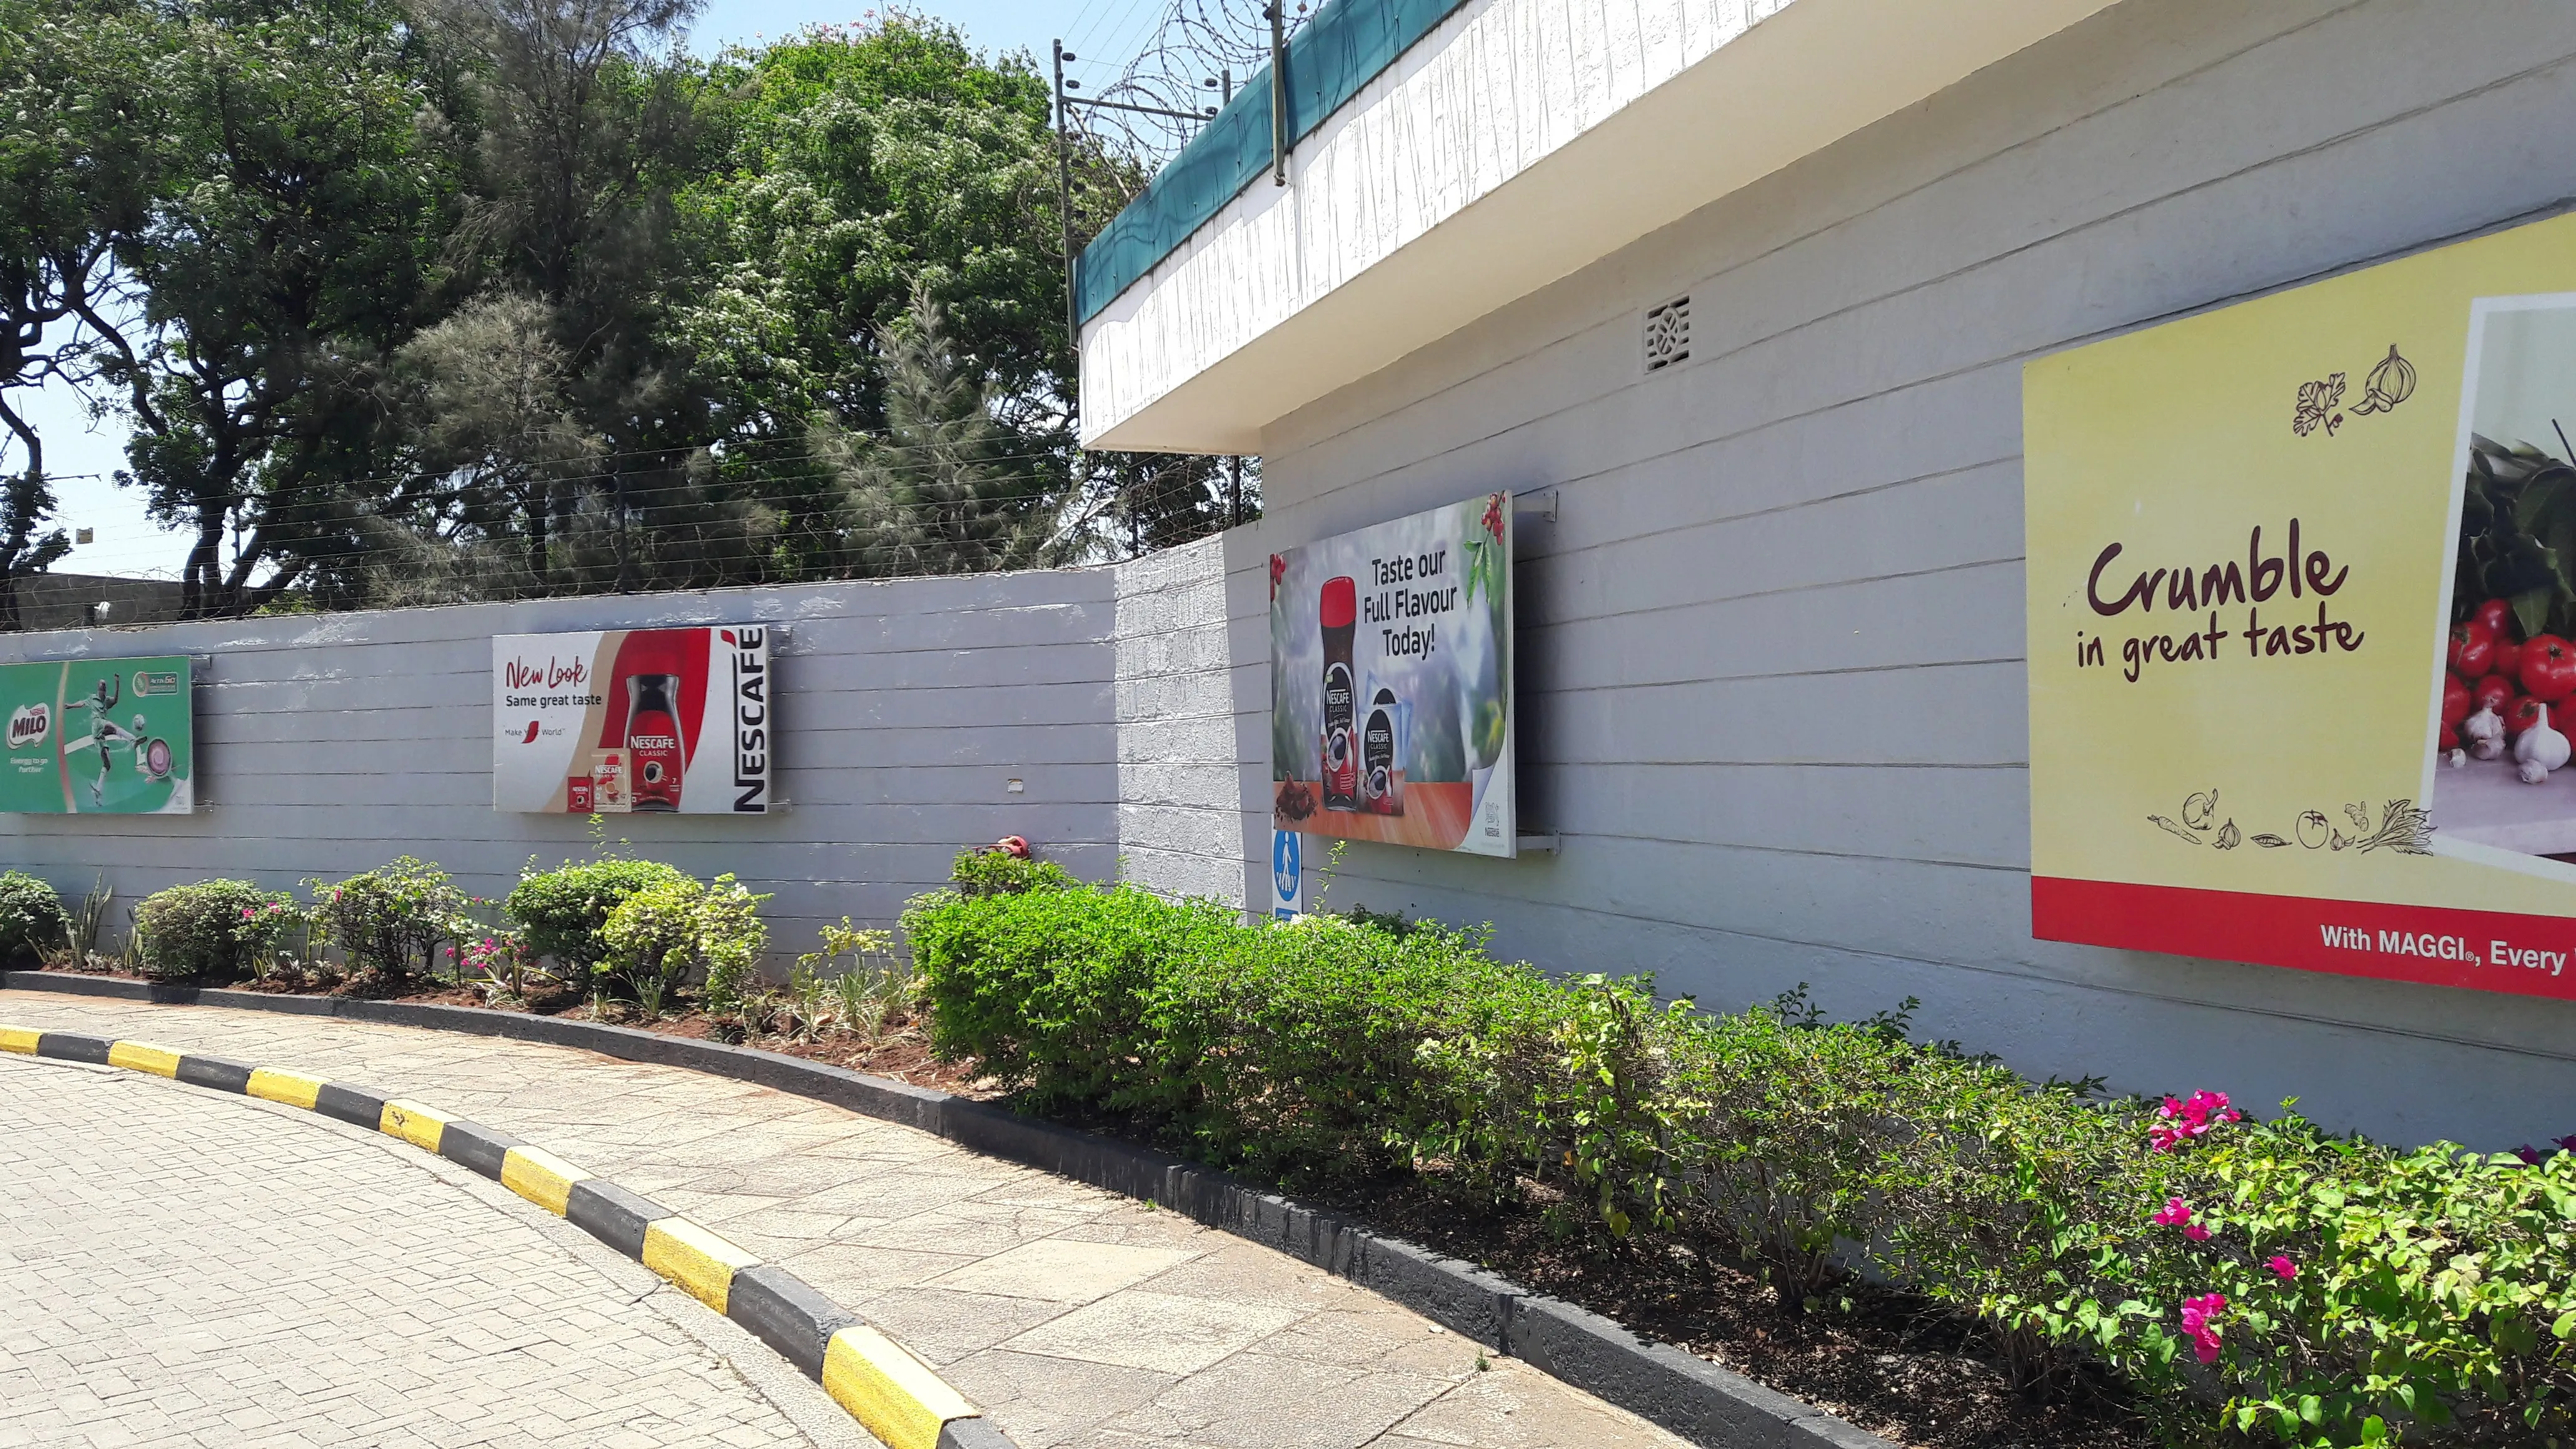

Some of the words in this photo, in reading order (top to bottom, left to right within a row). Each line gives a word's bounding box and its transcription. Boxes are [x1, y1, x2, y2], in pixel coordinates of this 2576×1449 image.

[1372, 555, 1413, 586] Taste
[1418, 550, 1445, 578] our
[2087, 517, 2348, 616] Crumble
[1365, 592, 1390, 623] Full
[1395, 587, 1457, 618] Flavour
[1382, 623, 1435, 661] Today!
[2077, 631, 2104, 667] in
[2123, 610, 2227, 682] great
[2243, 600, 2364, 657] taste
[506, 655, 543, 689] New
[548, 655, 587, 688] Look
[506, 695, 537, 706] Same
[540, 695, 569, 708] great
[572, 694, 602, 705] taste
[12, 715, 46, 738] MILO
[2320, 924, 2371, 951] With
[2490, 940, 2567, 976] Every
